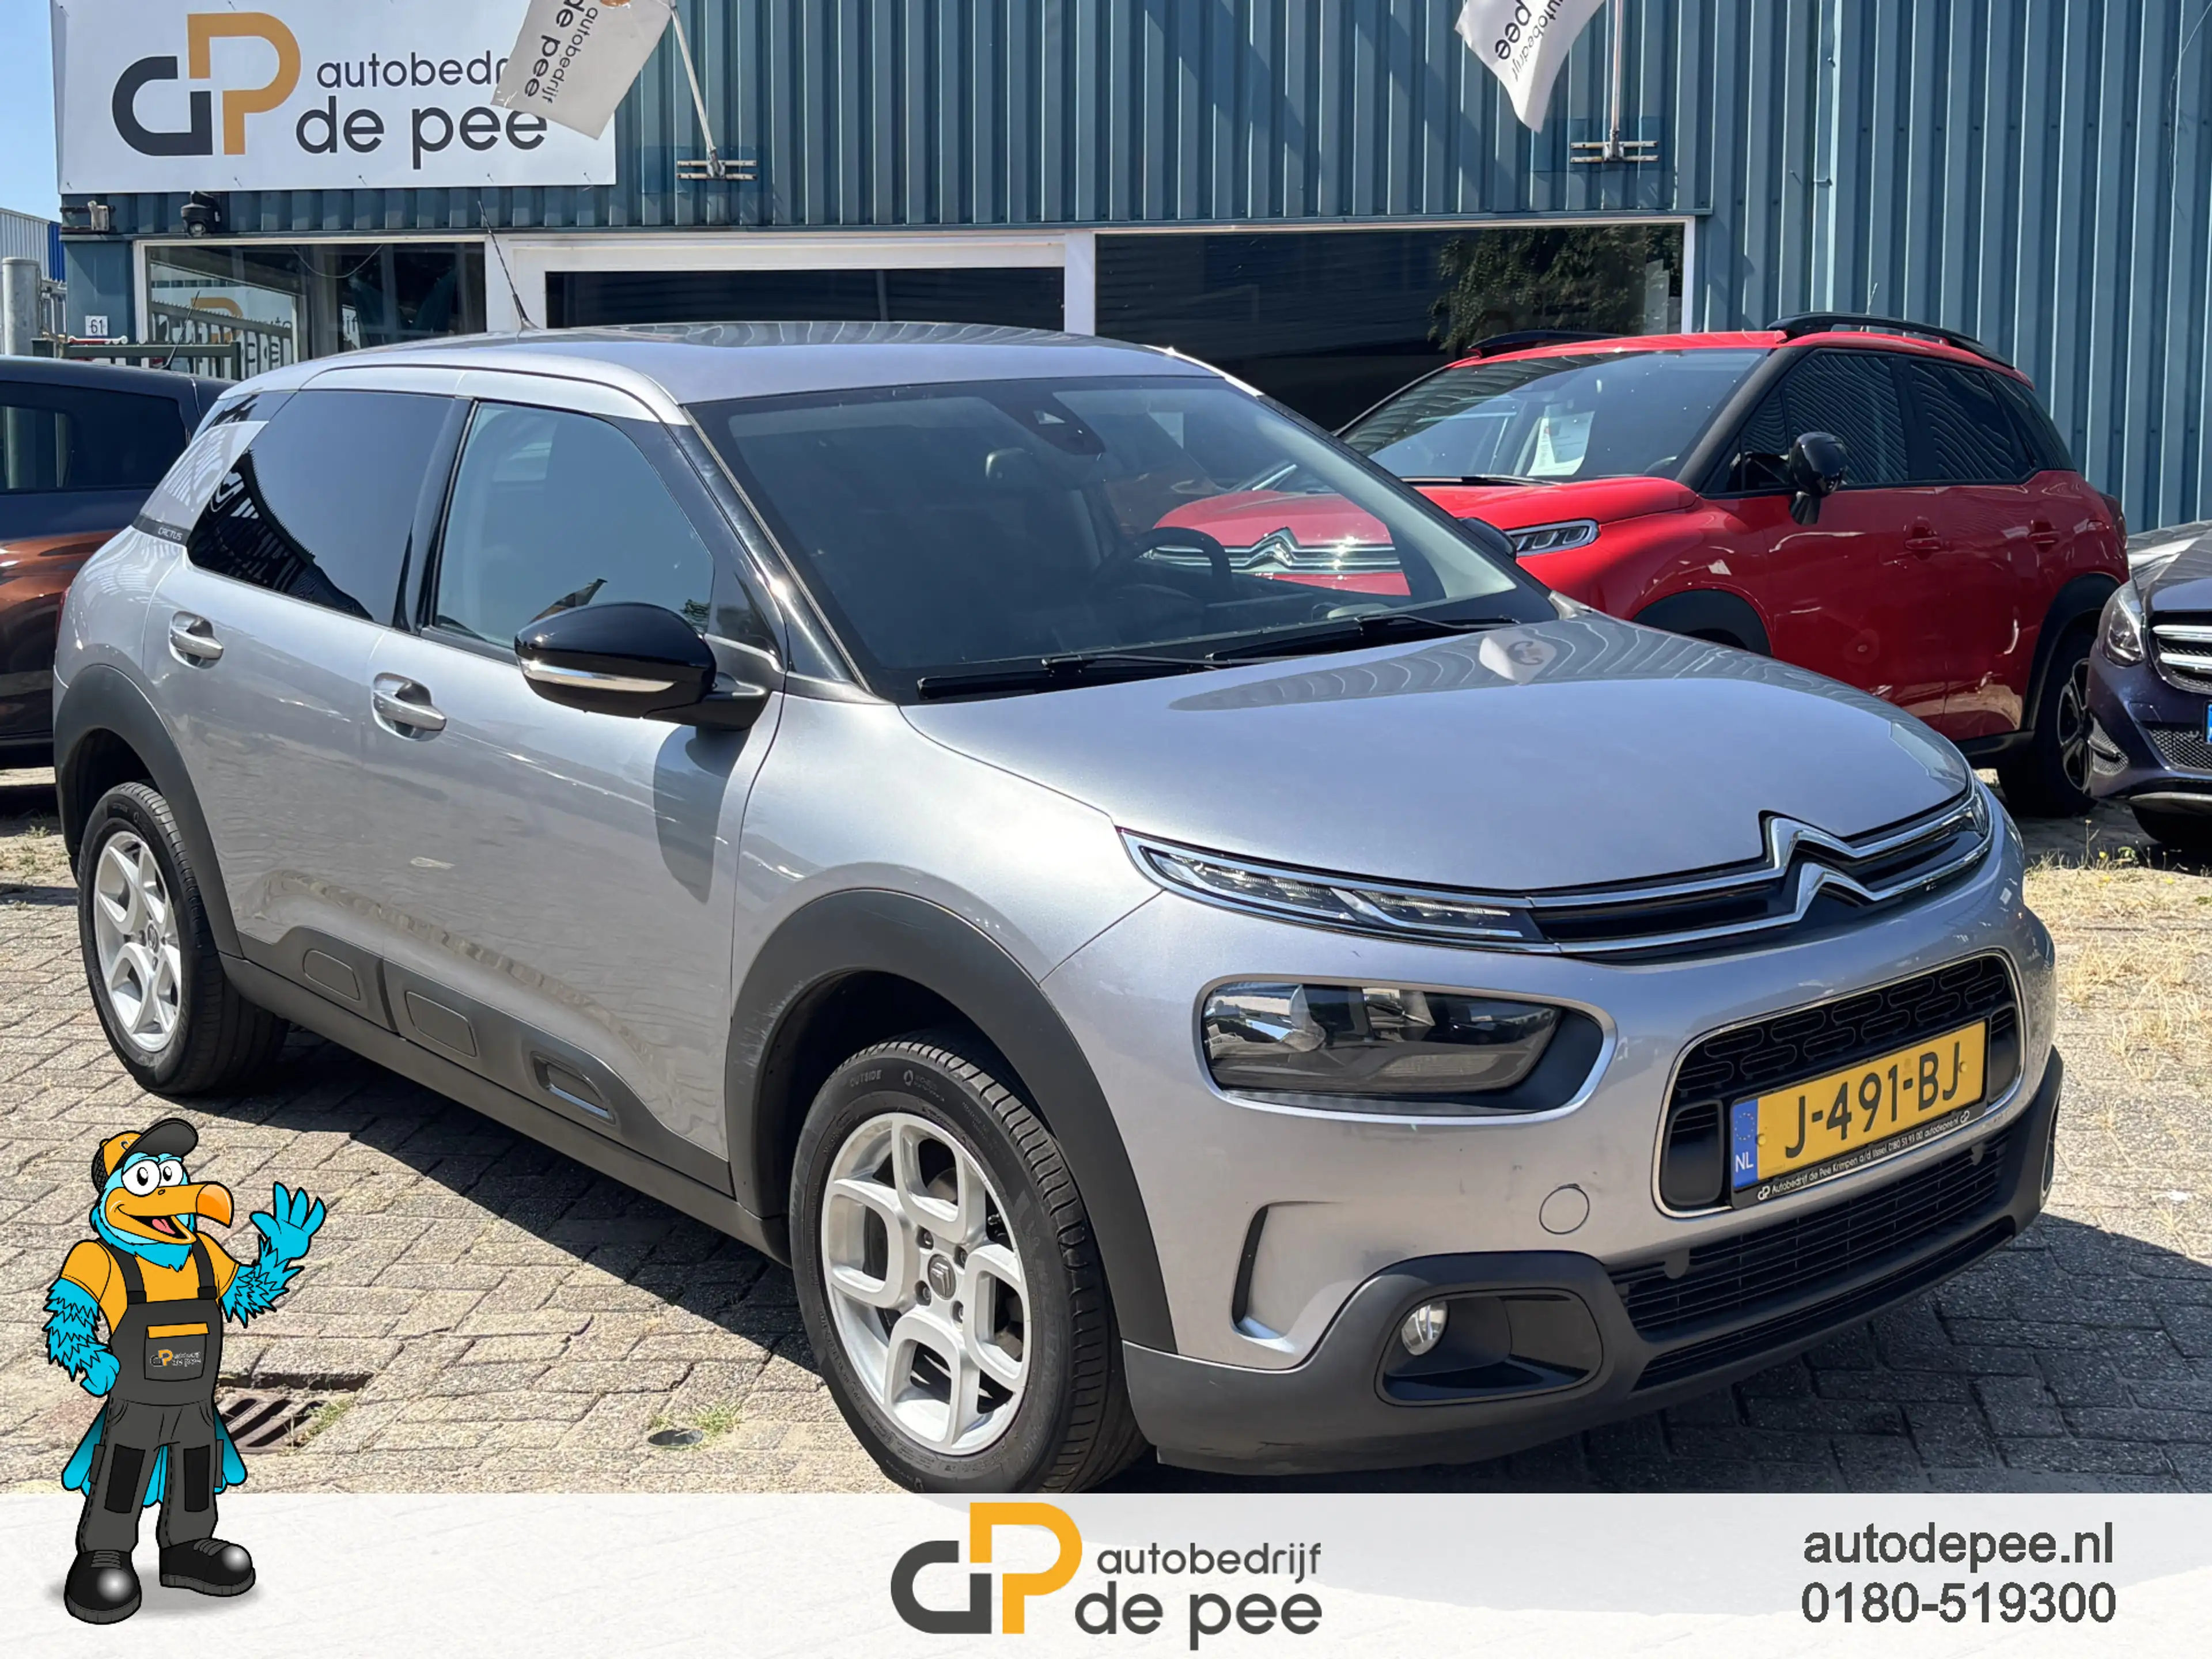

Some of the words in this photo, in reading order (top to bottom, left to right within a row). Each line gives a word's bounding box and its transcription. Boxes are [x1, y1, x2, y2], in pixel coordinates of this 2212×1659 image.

[541, 7, 599, 104] autobedrijf
[1495, 0, 1532, 60] pee
[1512, 0, 1563, 82] utobedrijf
[317, 50, 508, 89] autobedr
[525, 35, 561, 97] pee
[296, 95, 385, 154] de
[411, 105, 547, 170] pee
[91, 319, 103, 334] 61
[1785, 1040, 1960, 1159] J-491-BJ
[1735, 1151, 1754, 1173] NL
